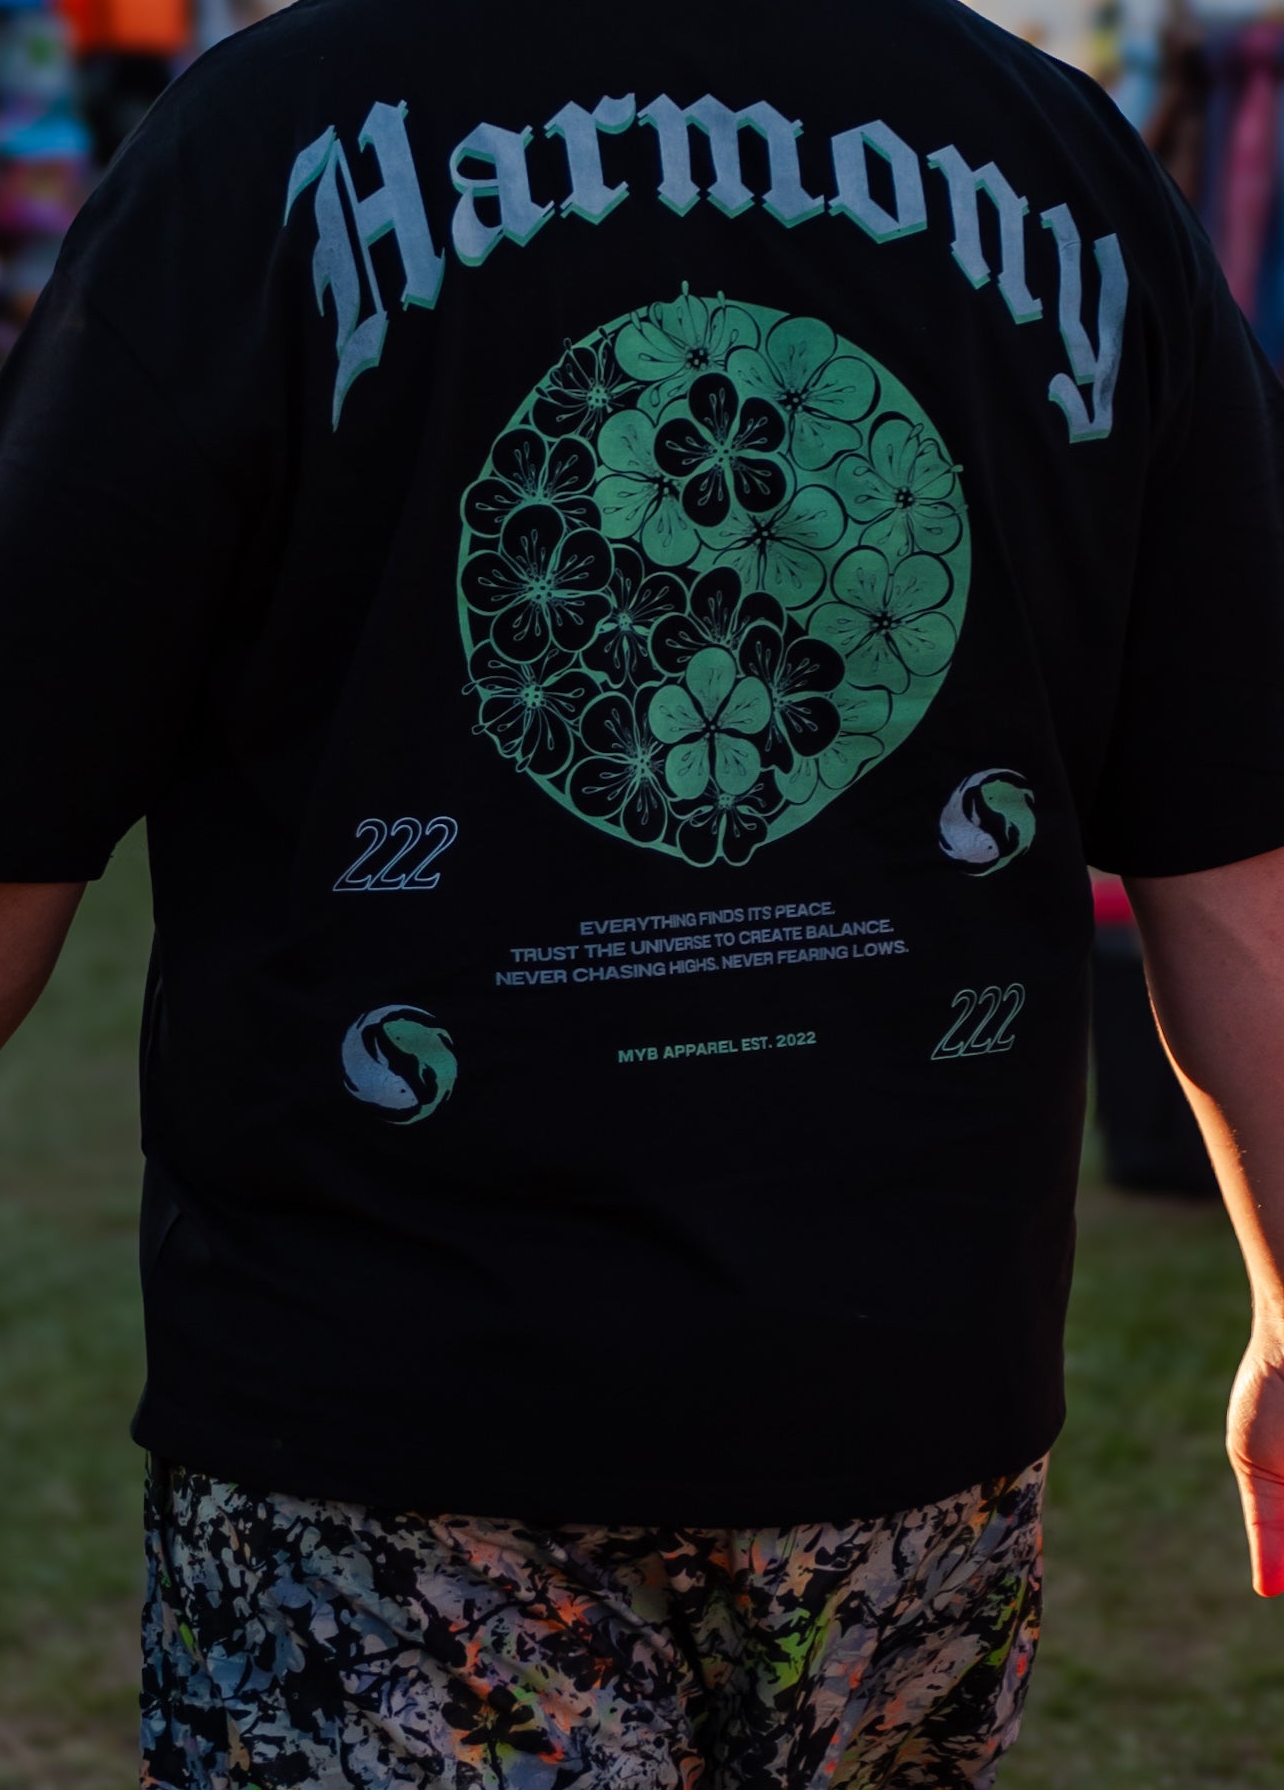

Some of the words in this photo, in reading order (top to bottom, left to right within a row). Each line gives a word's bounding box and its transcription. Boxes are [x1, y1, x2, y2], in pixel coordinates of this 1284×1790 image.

[284, 92, 1129, 444] Harmony
[332, 815, 459, 892] 222
[510, 945, 579, 963] TRUST
[583, 941, 627, 959] THE
[630, 934, 712, 956] UNIVERSE
[713, 931, 736, 948] TO
[738, 925, 804, 947] CREATE
[805, 918, 895, 940] BALANCE.
[579, 912, 698, 936] EVERYTHING
[699, 907, 745, 927] FINDS
[748, 905, 773, 922] ITS
[775, 901, 837, 919] PEACE.
[495, 969, 568, 986] NEVER
[572, 961, 667, 984] CHASING
[669, 956, 720, 975] HIGHS.
[721, 951, 774, 970] NEVER
[776, 945, 849, 965] FEARING
[852, 939, 910, 958] LOWS.
[930, 982, 1026, 1061] 222
[617, 1047, 659, 1064] MYB
[662, 1039, 739, 1060] APPAREL
[740, 1035, 773, 1052] EST.
[776, 1031, 817, 1048] 2022
